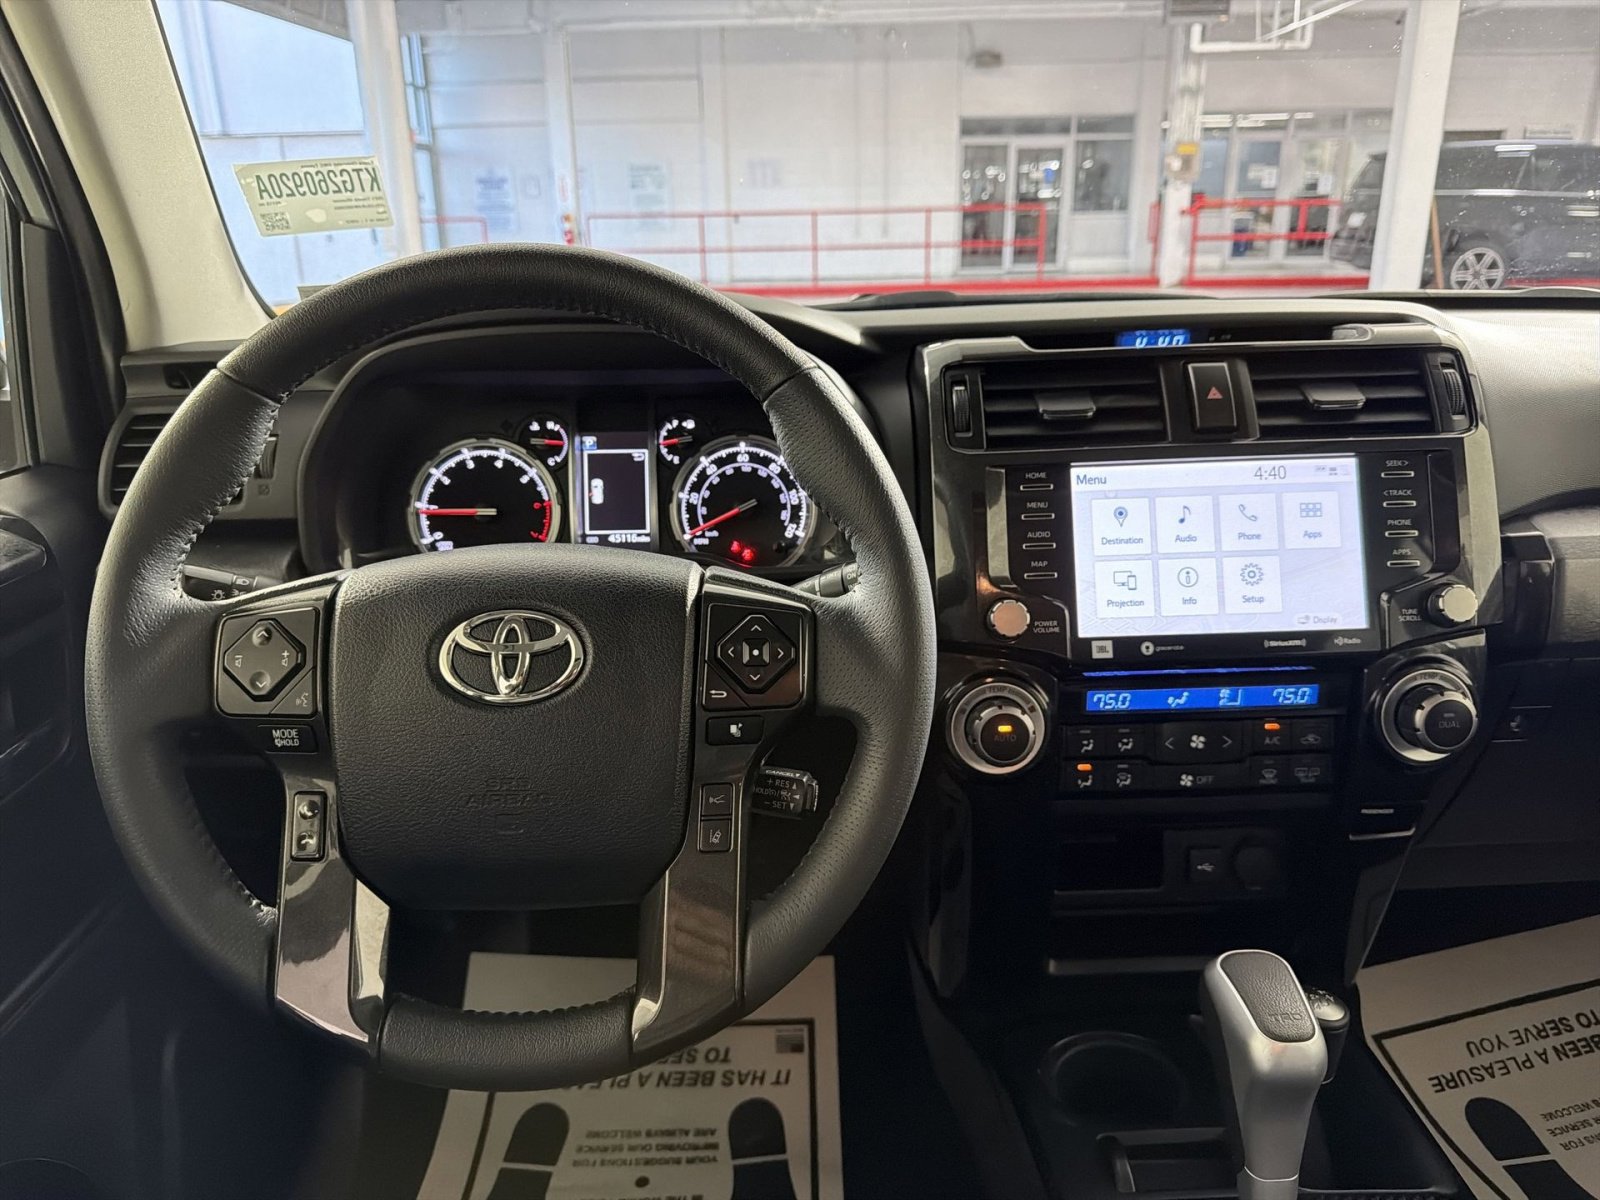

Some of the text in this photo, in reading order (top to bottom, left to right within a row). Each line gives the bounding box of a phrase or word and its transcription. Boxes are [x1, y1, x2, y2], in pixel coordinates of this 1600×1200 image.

[1253, 465, 1287, 480] 4:40
[1076, 474, 1107, 485] Menu
[1174, 534, 1197, 544] Audio
[1238, 532, 1261, 540] Phone
[1303, 530, 1322, 540] Apps
[1101, 537, 1143, 546] Destination
[1107, 599, 1144, 608] Projection
[1182, 597, 1197, 605] Info
[1242, 595, 1264, 604] Setup
[1312, 616, 1338, 624] Display
[1093, 692, 1132, 710] 75.0
[1272, 687, 1310, 705] 75.0
[272, 729, 300, 739] MODE
[993, 734, 1016, 743] AUTO
[280, 739, 300, 747] HOLD
[1264, 736, 1280, 745] A/C
[775, 779, 790, 789] RES
[772, 801, 786, 809] SET
[1508, 1016, 1575, 1047] SERVE
[1465, 1034, 1509, 1058] YOU
[704, 1046, 732, 1064] TO
[1536, 1048, 1551, 1064] A
[656, 1070, 715, 1087] BEEN
[721, 1069, 767, 1087] HAS
[770, 1069, 792, 1085] IT
[1428, 1052, 1535, 1094] PLEASURE
[637, 1071, 653, 1088] A
[1539, 1102, 1594, 1122] WELCOME
[1546, 1119, 1593, 1137] SERVICE
[1559, 1138, 1585, 1151] FOR
